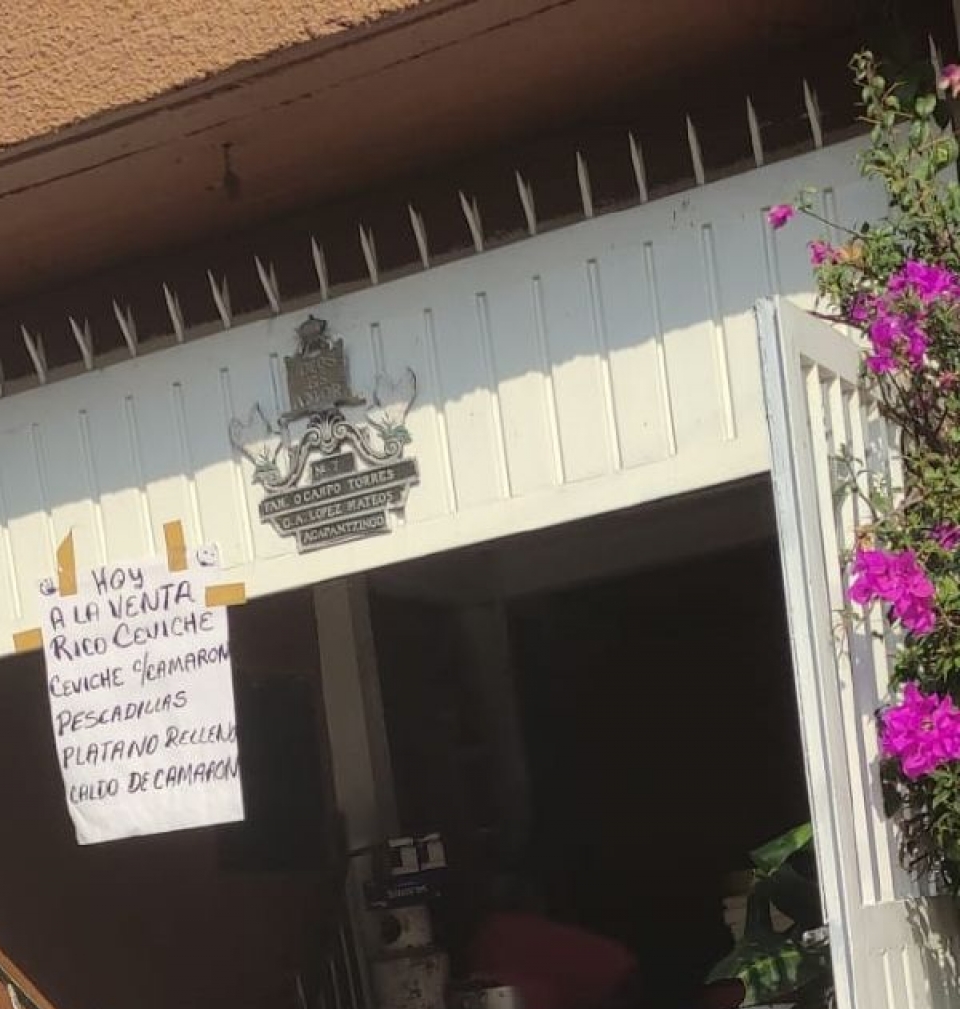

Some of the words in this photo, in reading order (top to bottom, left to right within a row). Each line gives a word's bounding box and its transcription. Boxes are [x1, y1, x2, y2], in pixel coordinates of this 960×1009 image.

[294, 484, 340, 505] OCAMPO
[348, 469, 395, 490] TORRES
[308, 503, 341, 521] LOPEZ
[346, 491, 393, 511] MATEOS
[302, 515, 385, 543] ACAPANTZINGO
[91, 566, 144, 595] HOY
[50, 607, 64, 632] A
[73, 602, 100, 624] LA
[108, 580, 195, 620] VENTA
[50, 634, 108, 662] RICO
[113, 612, 215, 649] CEVICHE
[49, 667, 124, 697] CEVICHE
[57, 690, 188, 736] PESCADILLAS
[62, 735, 159, 769] PLATANO
[69, 779, 118, 804] CALDO
